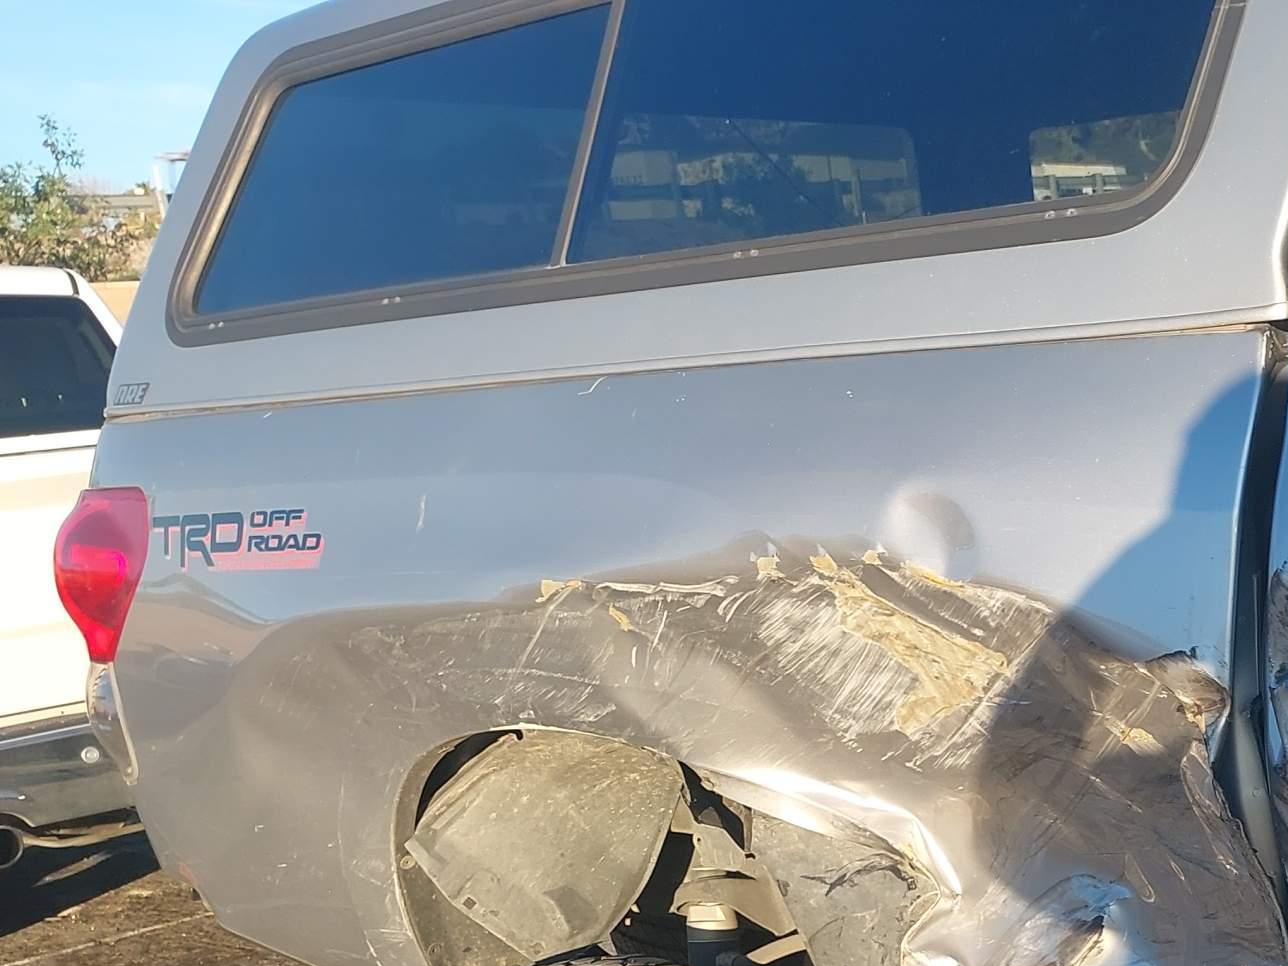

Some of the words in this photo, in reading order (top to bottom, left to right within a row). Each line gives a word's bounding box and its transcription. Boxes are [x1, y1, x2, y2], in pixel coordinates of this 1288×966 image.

[250, 509, 305, 528] OFF
[153, 512, 244, 568] TRD
[248, 533, 322, 553] ROAD
